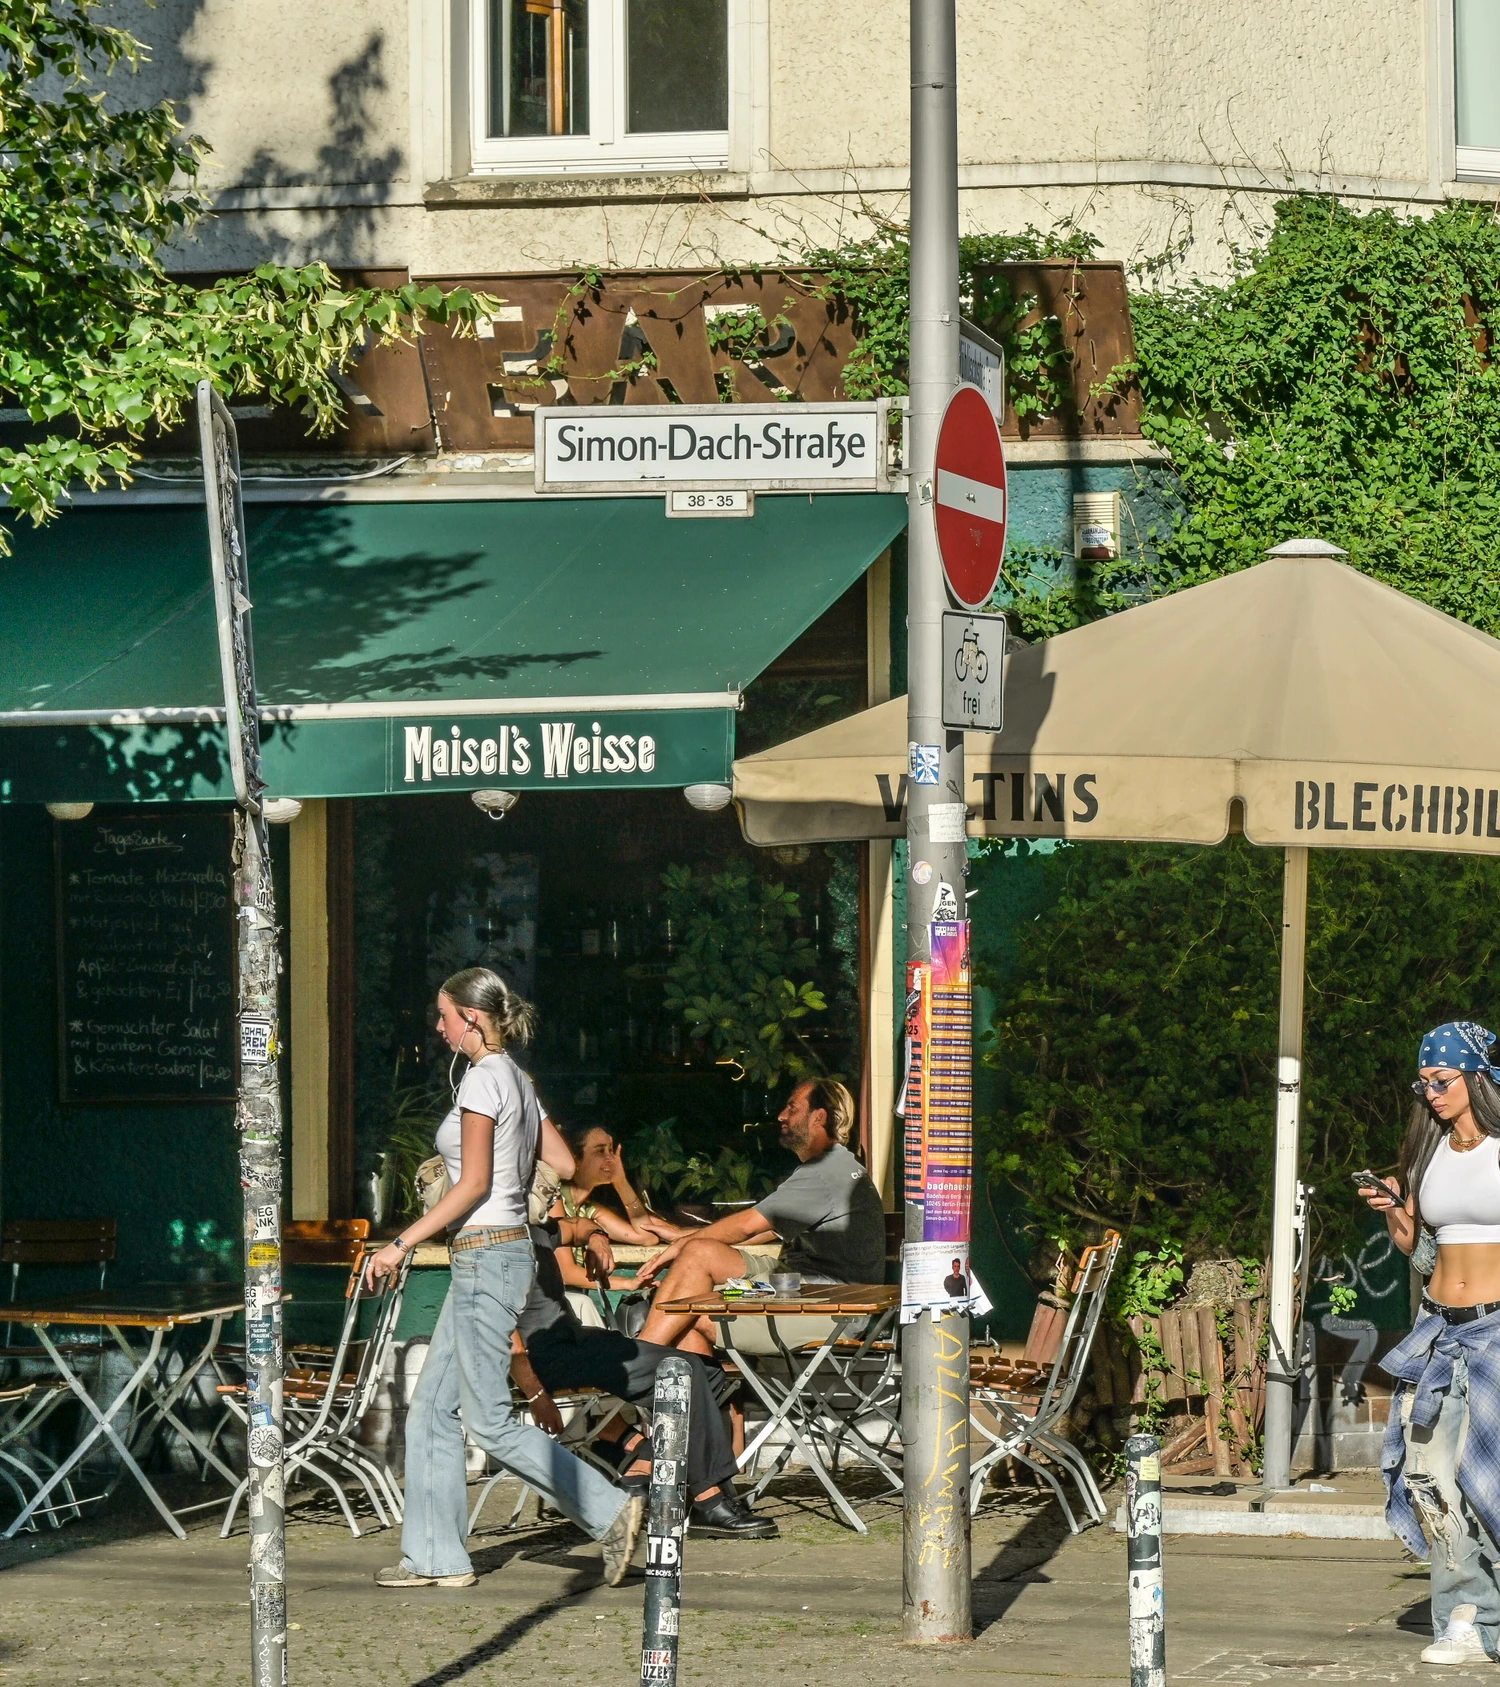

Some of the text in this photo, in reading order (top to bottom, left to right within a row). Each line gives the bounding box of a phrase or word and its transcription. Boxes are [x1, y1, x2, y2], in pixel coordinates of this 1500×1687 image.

[557, 419, 866, 469] Simon-Dach-Straße
[687, 494, 706, 508] 38
[716, 494, 734, 508] 35
[962, 690, 982, 716] frei
[404, 721, 656, 782] Maisel's Weisse
[875, 772, 1099, 824] VTINS
[646, 1535, 678, 1565] TB
[655, 1569, 671, 1577] BOYS
